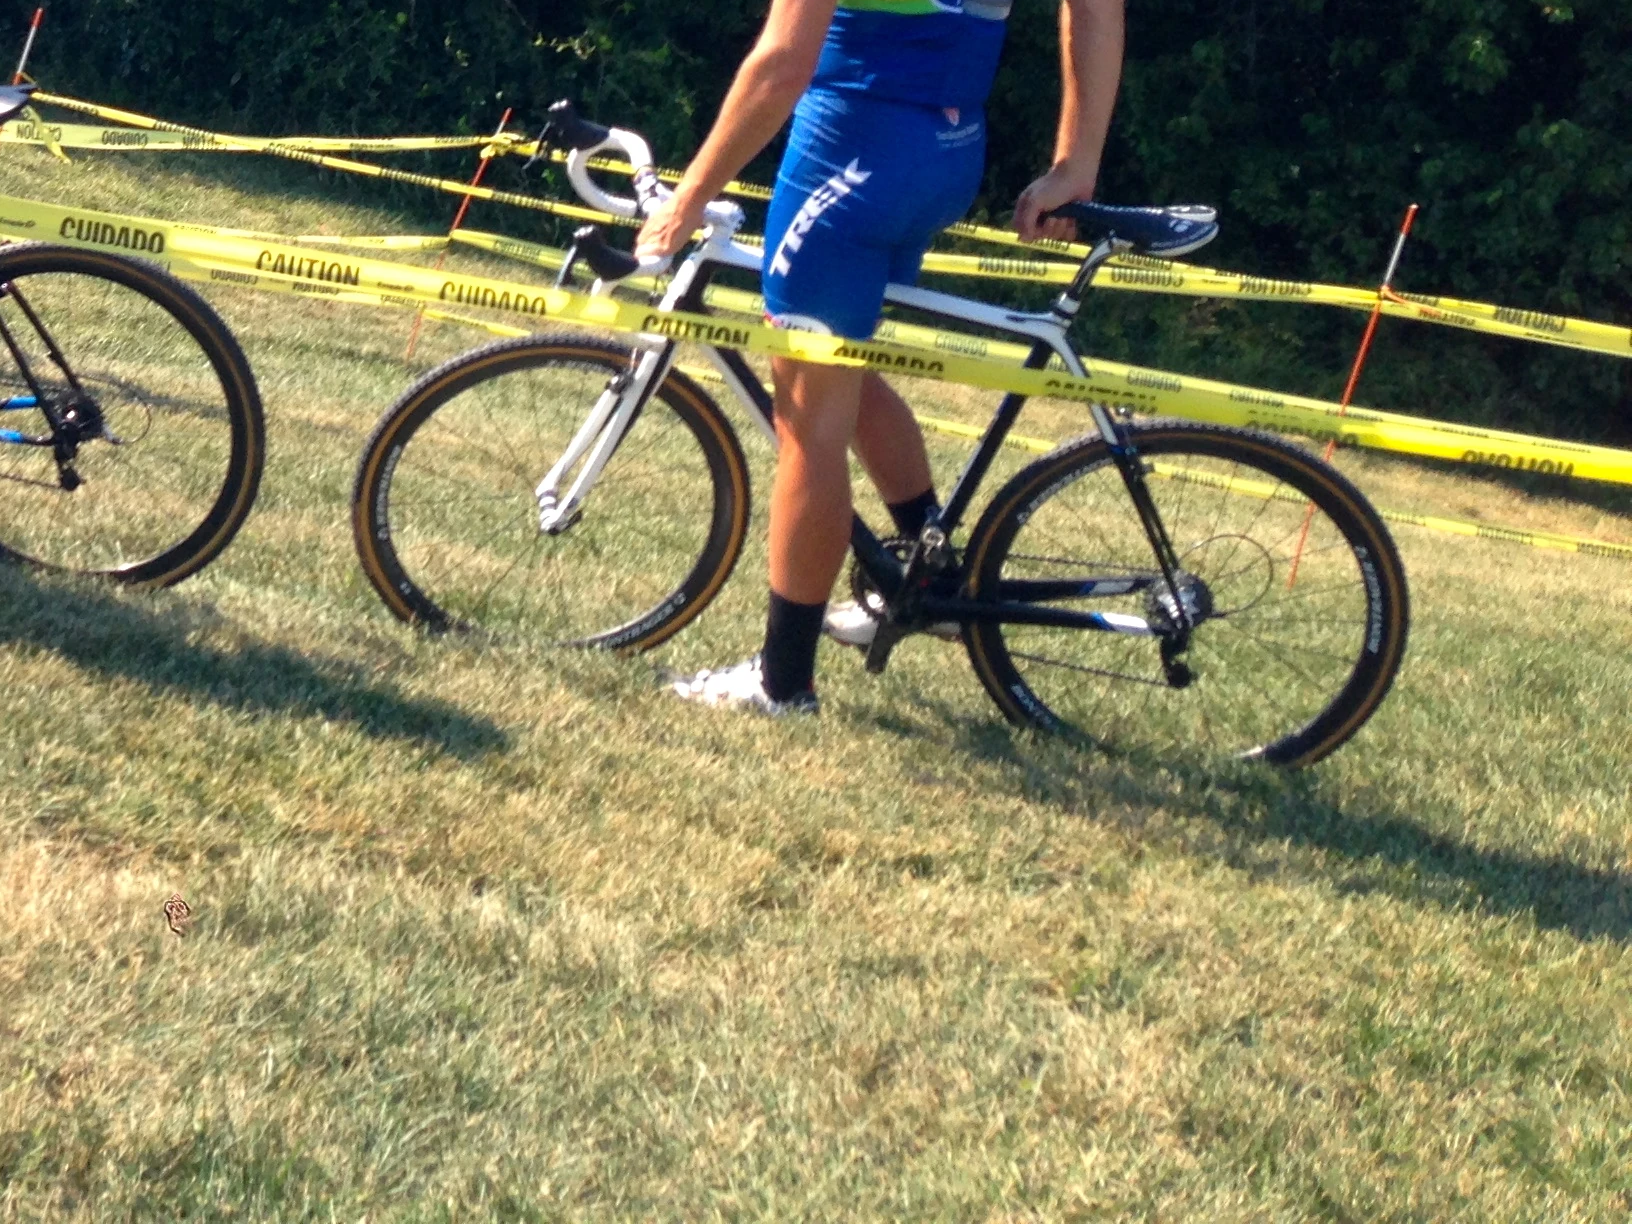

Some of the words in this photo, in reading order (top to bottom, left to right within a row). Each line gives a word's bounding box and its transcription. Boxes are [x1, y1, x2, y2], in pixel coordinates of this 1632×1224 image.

[769, 157, 872, 276] TREK
[59, 216, 165, 254] CUIDADO
[255, 250, 361, 287] CAUTION
[439, 281, 547, 316] CUIDADO
[642, 314, 751, 347] CAUTION
